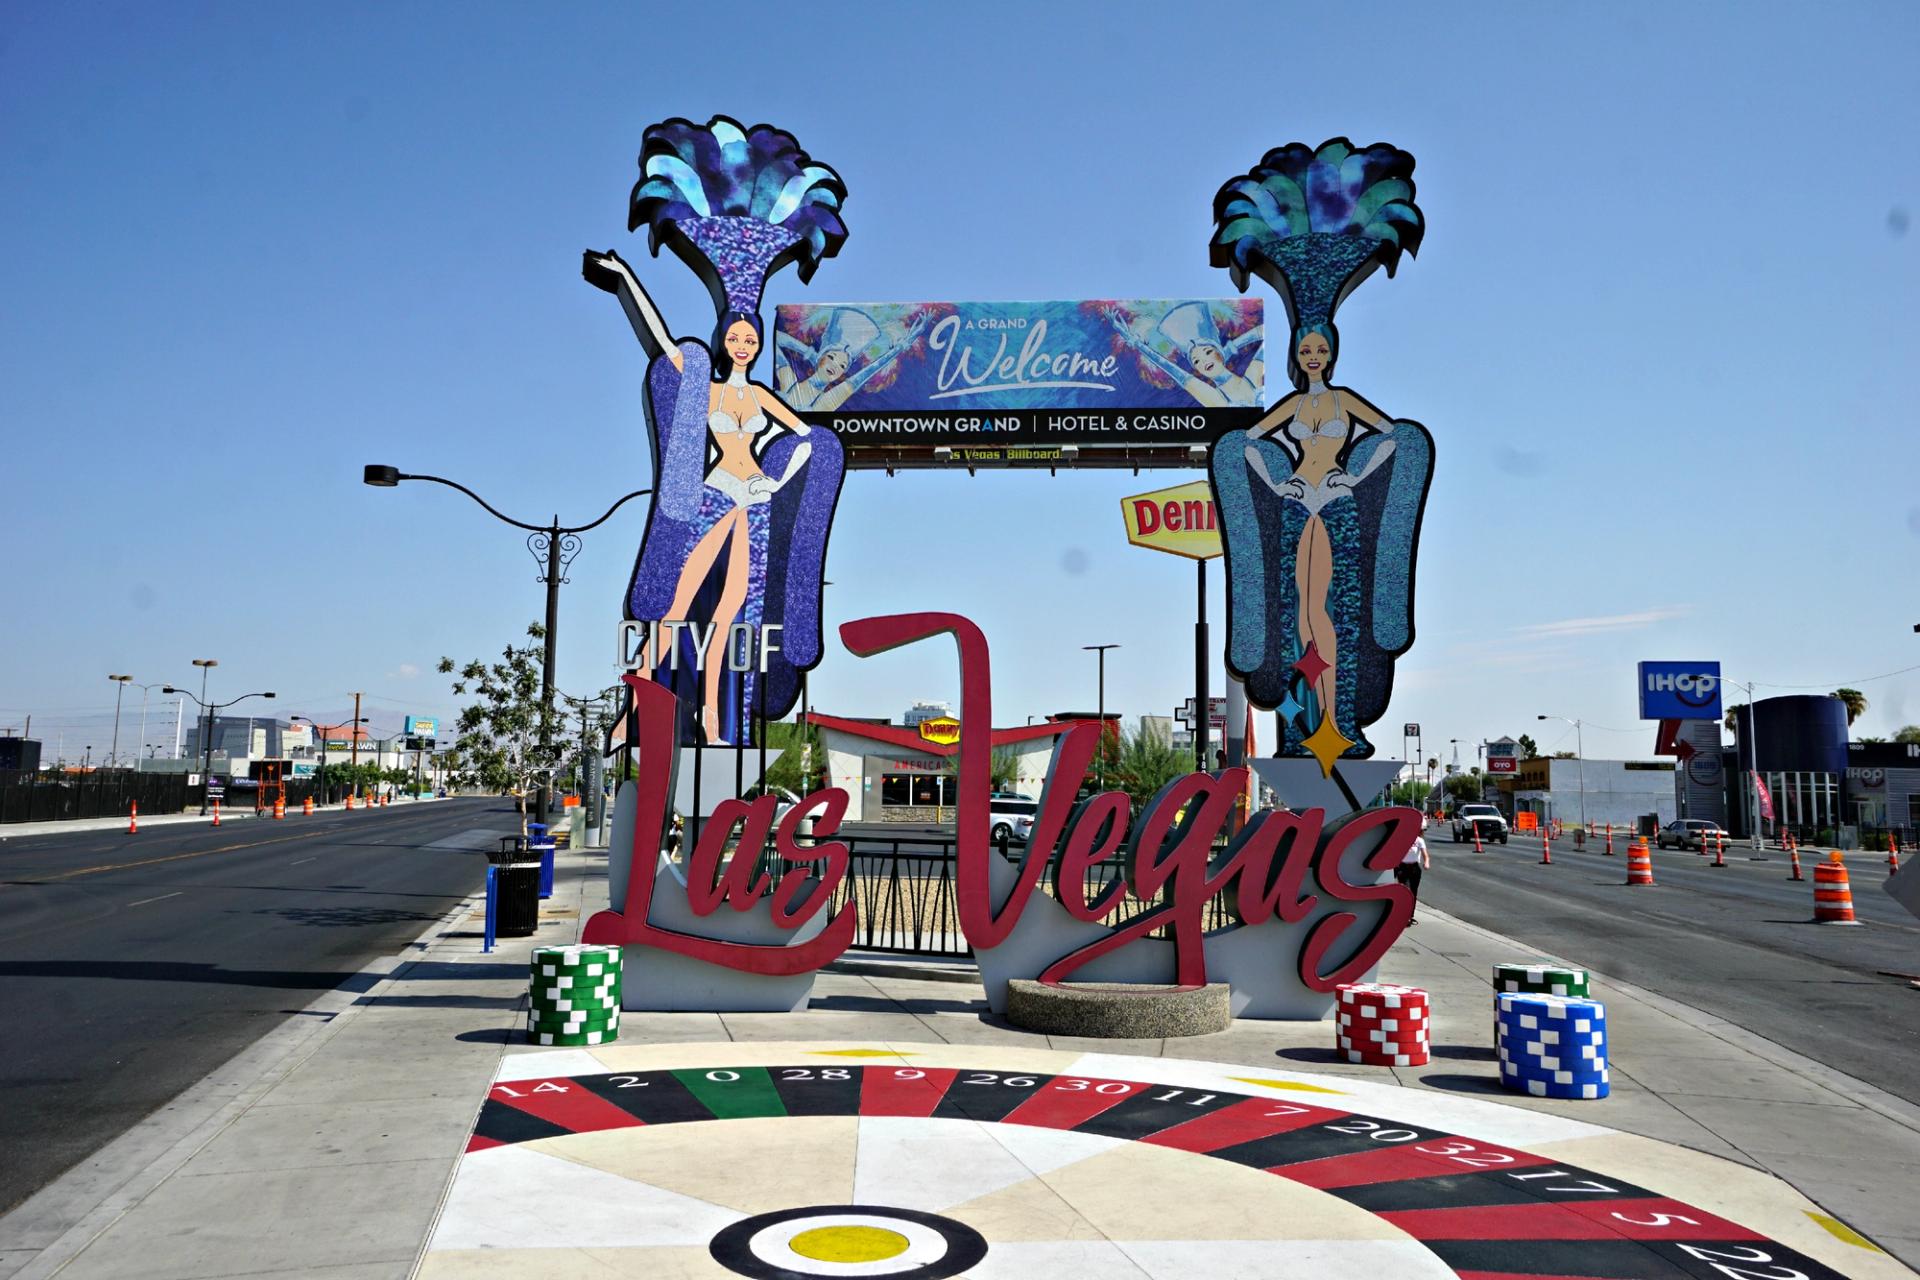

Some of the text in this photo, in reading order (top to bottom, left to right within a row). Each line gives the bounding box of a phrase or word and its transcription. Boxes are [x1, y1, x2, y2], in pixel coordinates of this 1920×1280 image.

[965, 318, 1027, 330] A GRAND
[929, 315, 1119, 391] Welcome
[833, 415, 1206, 433] DOWNTOWN GRAND HOTEL & CASINO
[1008, 449, 1063, 460] Billboard
[618, 620, 784, 673] CITY OF
[582, 611, 1422, 993] Las Vegas
[494, 1082, 571, 1098] 14
[608, 1076, 649, 1088] 2
[705, 1070, 741, 1082] 0
[781, 1069, 852, 1081] 28
[894, 1070, 926, 1080] 9
[962, 1073, 1039, 1087] 26
[1055, 1080, 1131, 1094] 30
[1152, 1090, 1217, 1106] 11
[1264, 1105, 1311, 1116] 7
[1324, 1120, 1418, 1142] 20
[1415, 1142, 1515, 1167] 32
[1507, 1169, 1619, 1194] 17
[1611, 1212, 1702, 1226] 5
